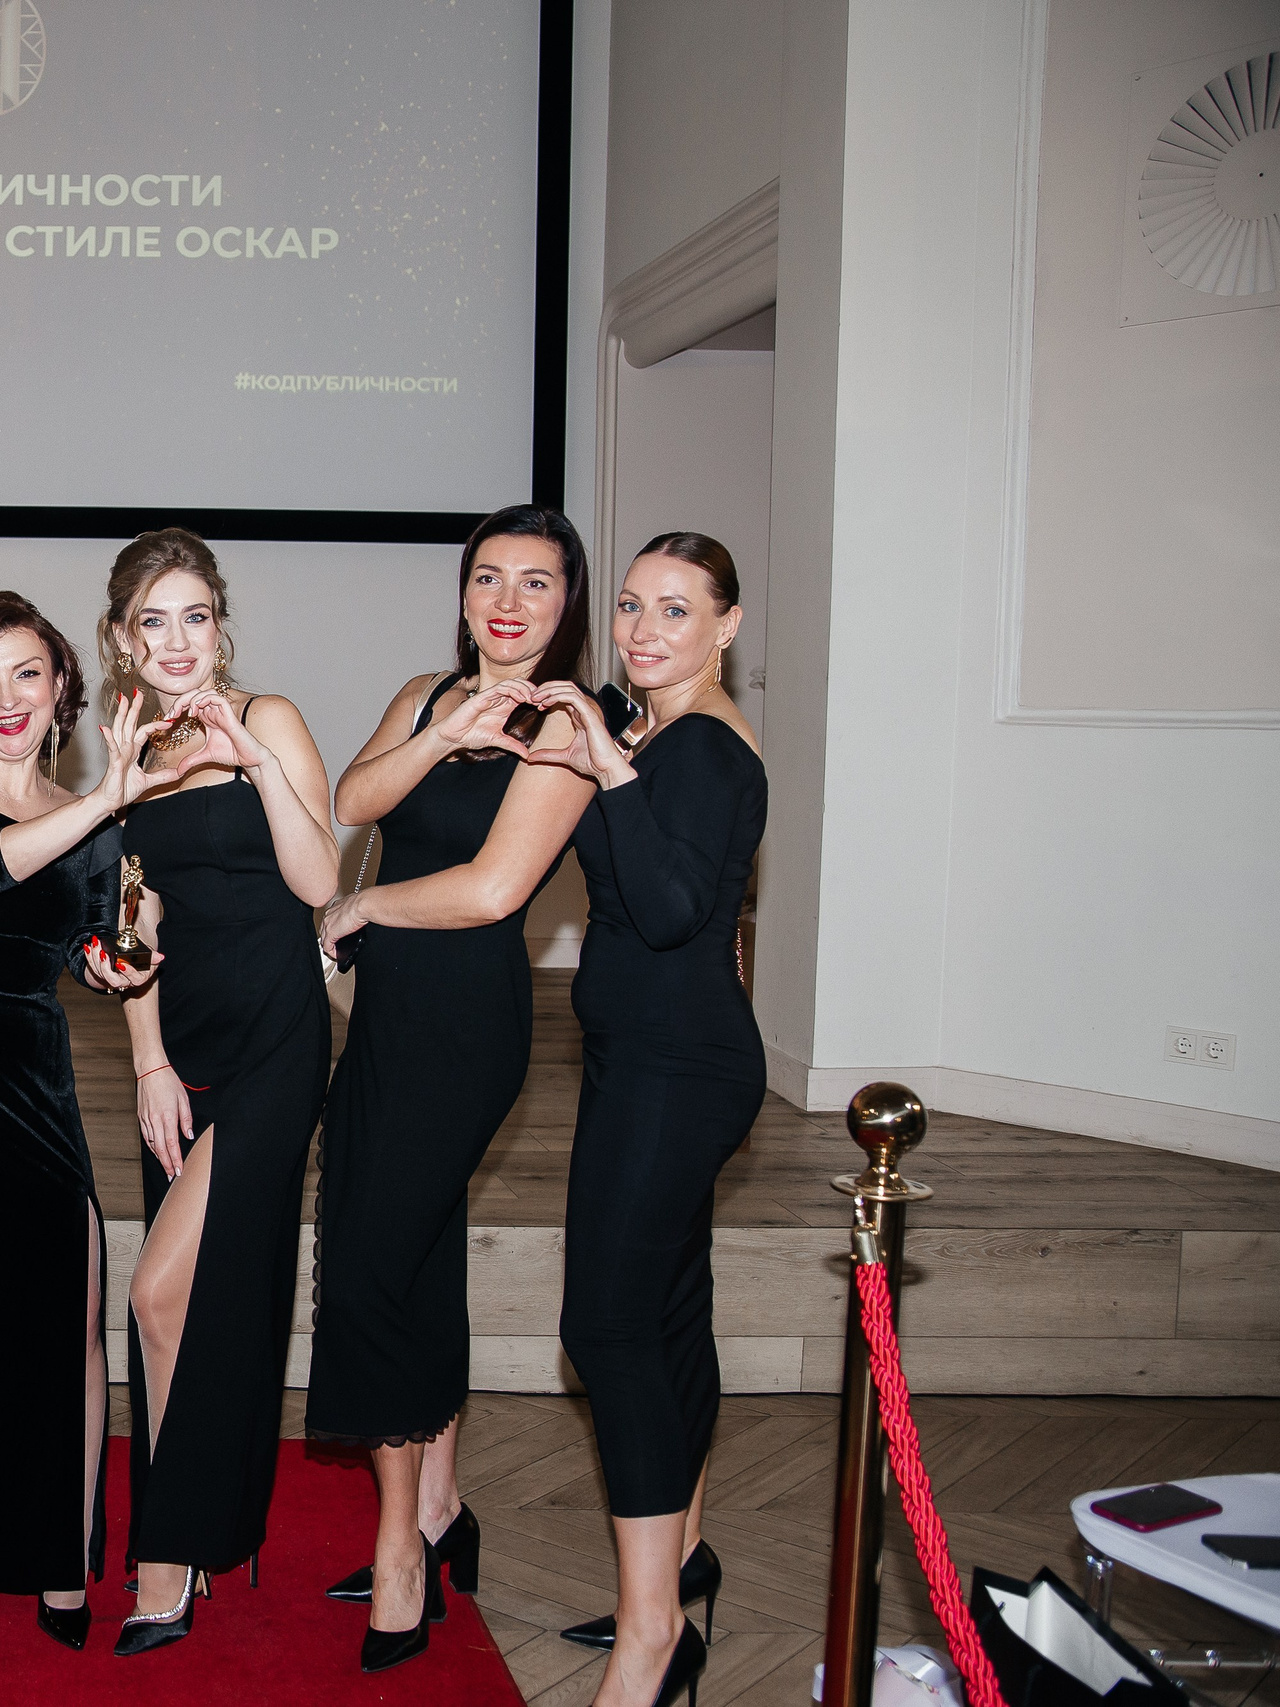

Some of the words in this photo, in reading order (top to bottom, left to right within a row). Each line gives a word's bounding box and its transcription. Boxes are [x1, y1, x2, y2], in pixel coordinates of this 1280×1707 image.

[6, 226, 161, 258] СТИЛЕ
[176, 227, 339, 259] ОСКАР
[235, 372, 458, 393] #КОДПУБЛИЧНОСТИ
